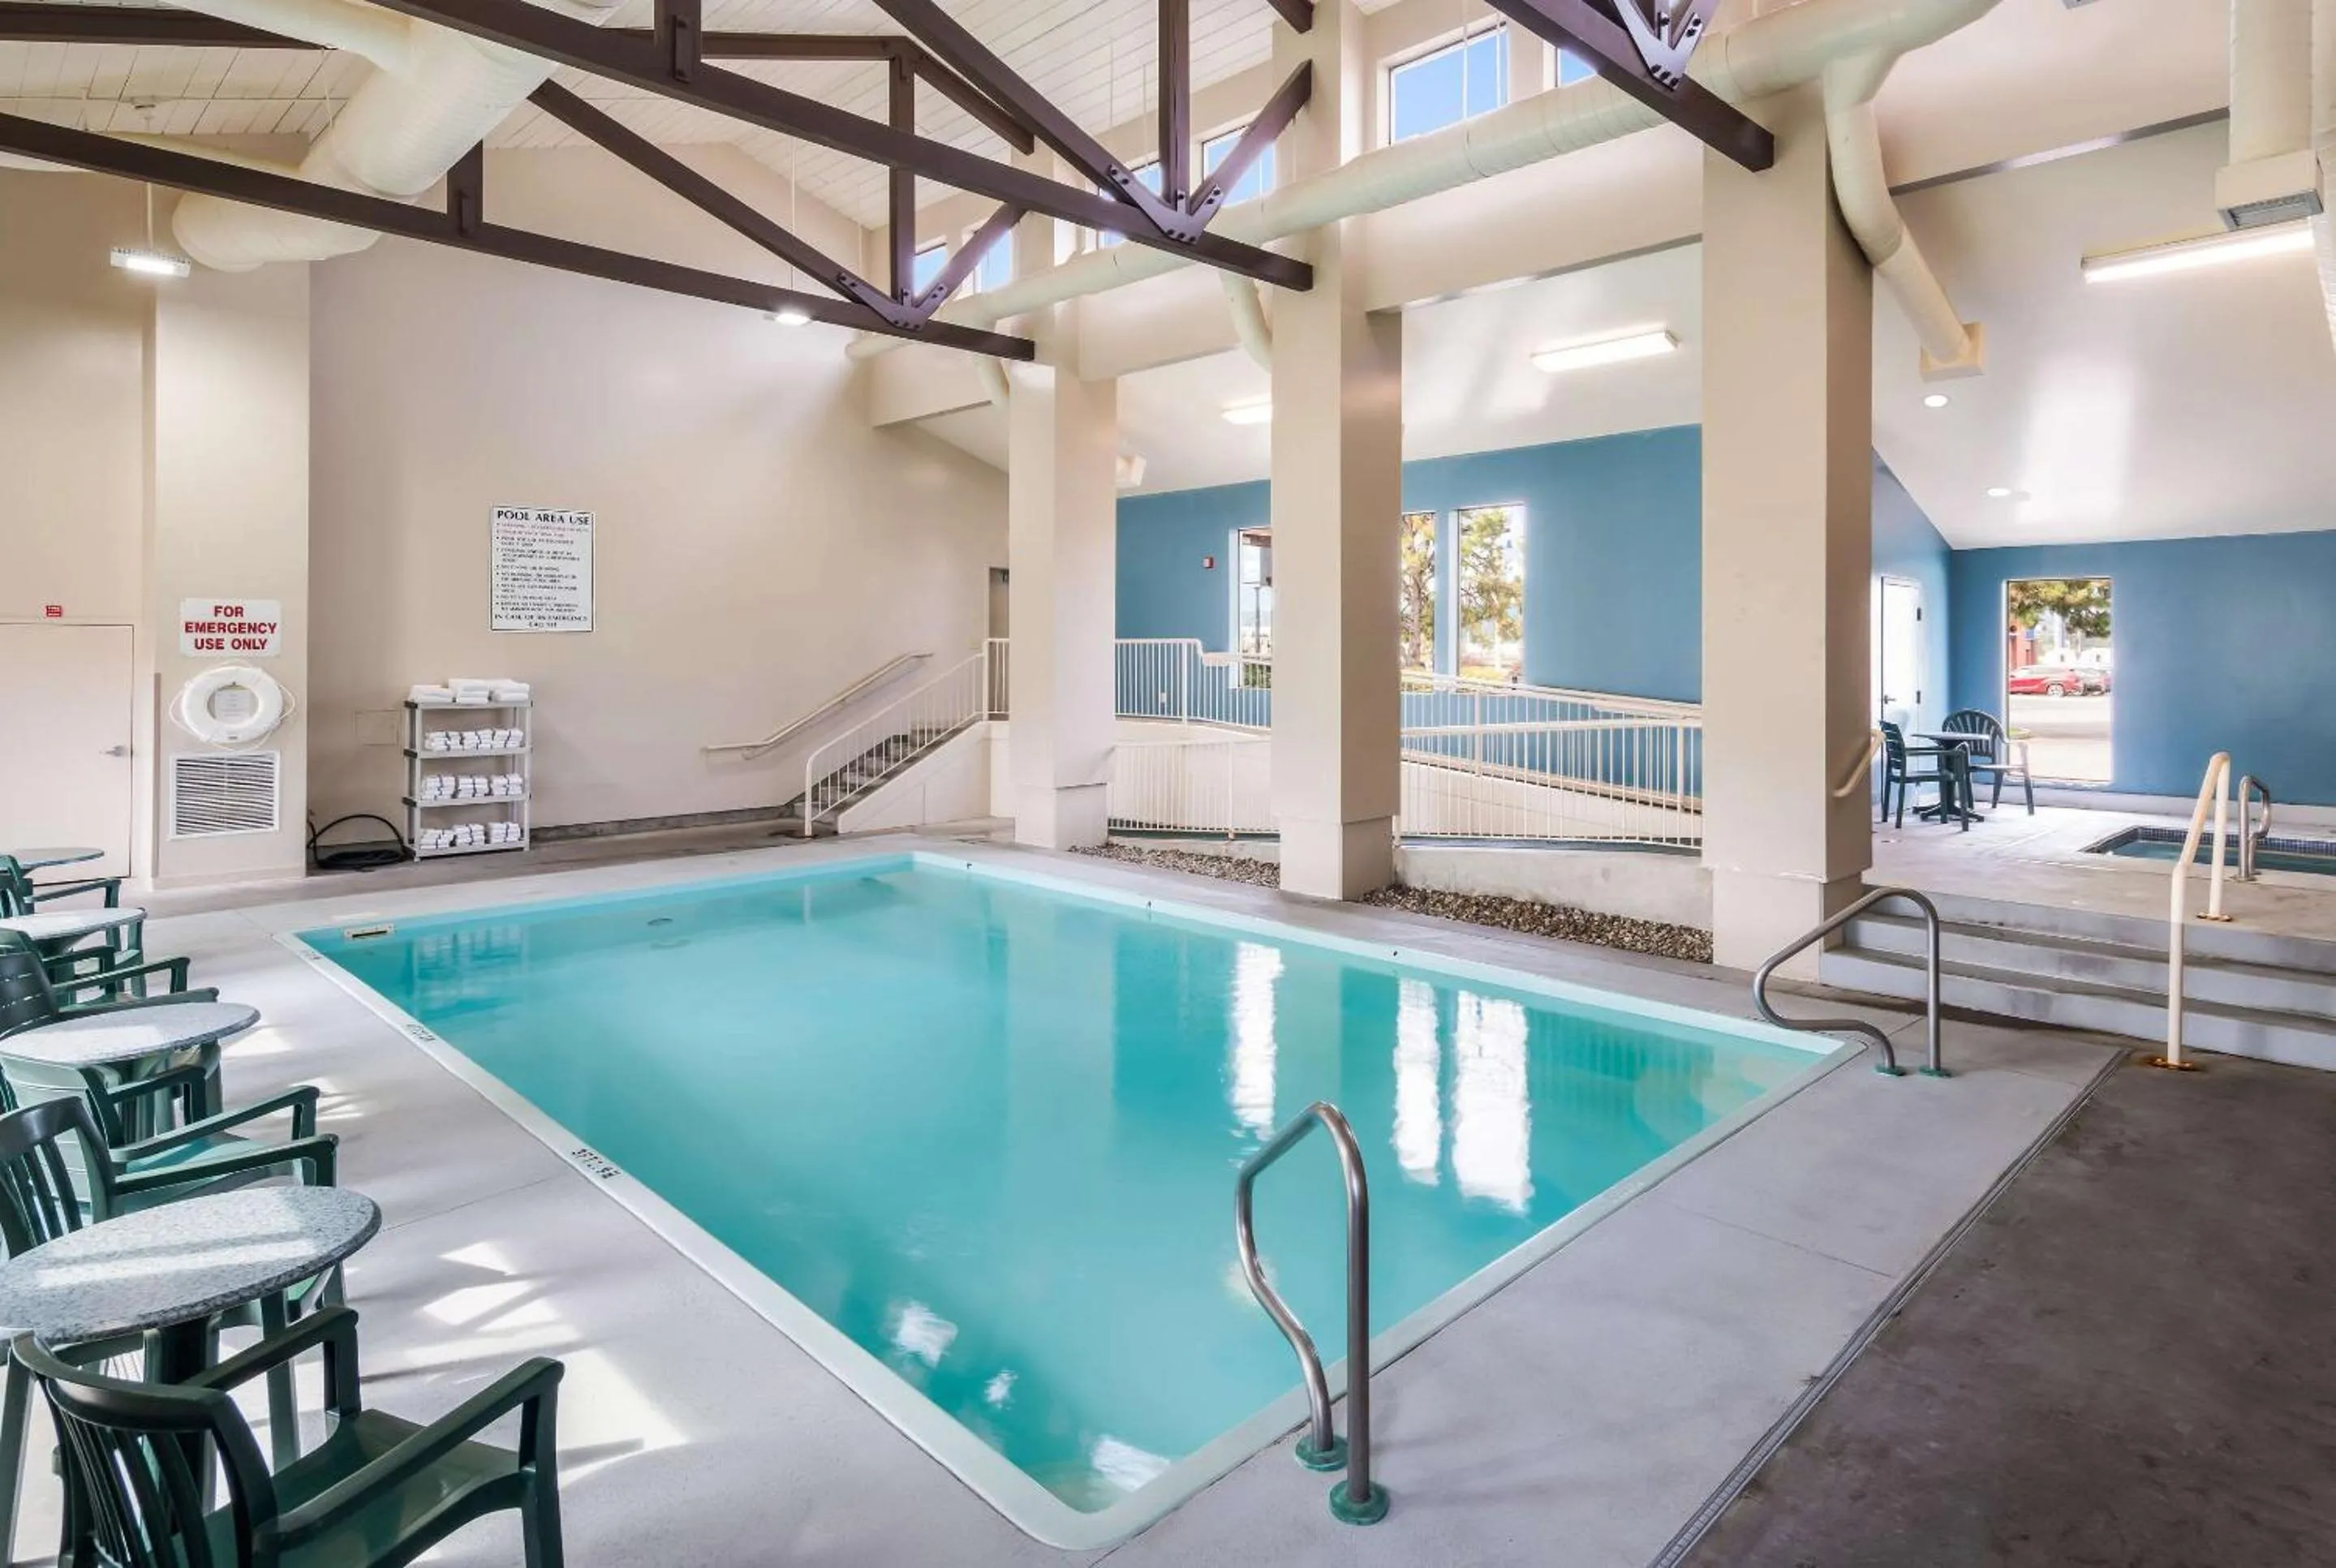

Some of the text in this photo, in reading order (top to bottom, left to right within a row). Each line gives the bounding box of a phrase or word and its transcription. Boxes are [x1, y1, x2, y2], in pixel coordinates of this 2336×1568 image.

[497, 510, 590, 526] POOL AREA USE
[214, 605, 244, 617] FOR
[184, 622, 277, 634] EMERGENCY
[194, 638, 268, 650] USE ONLY
